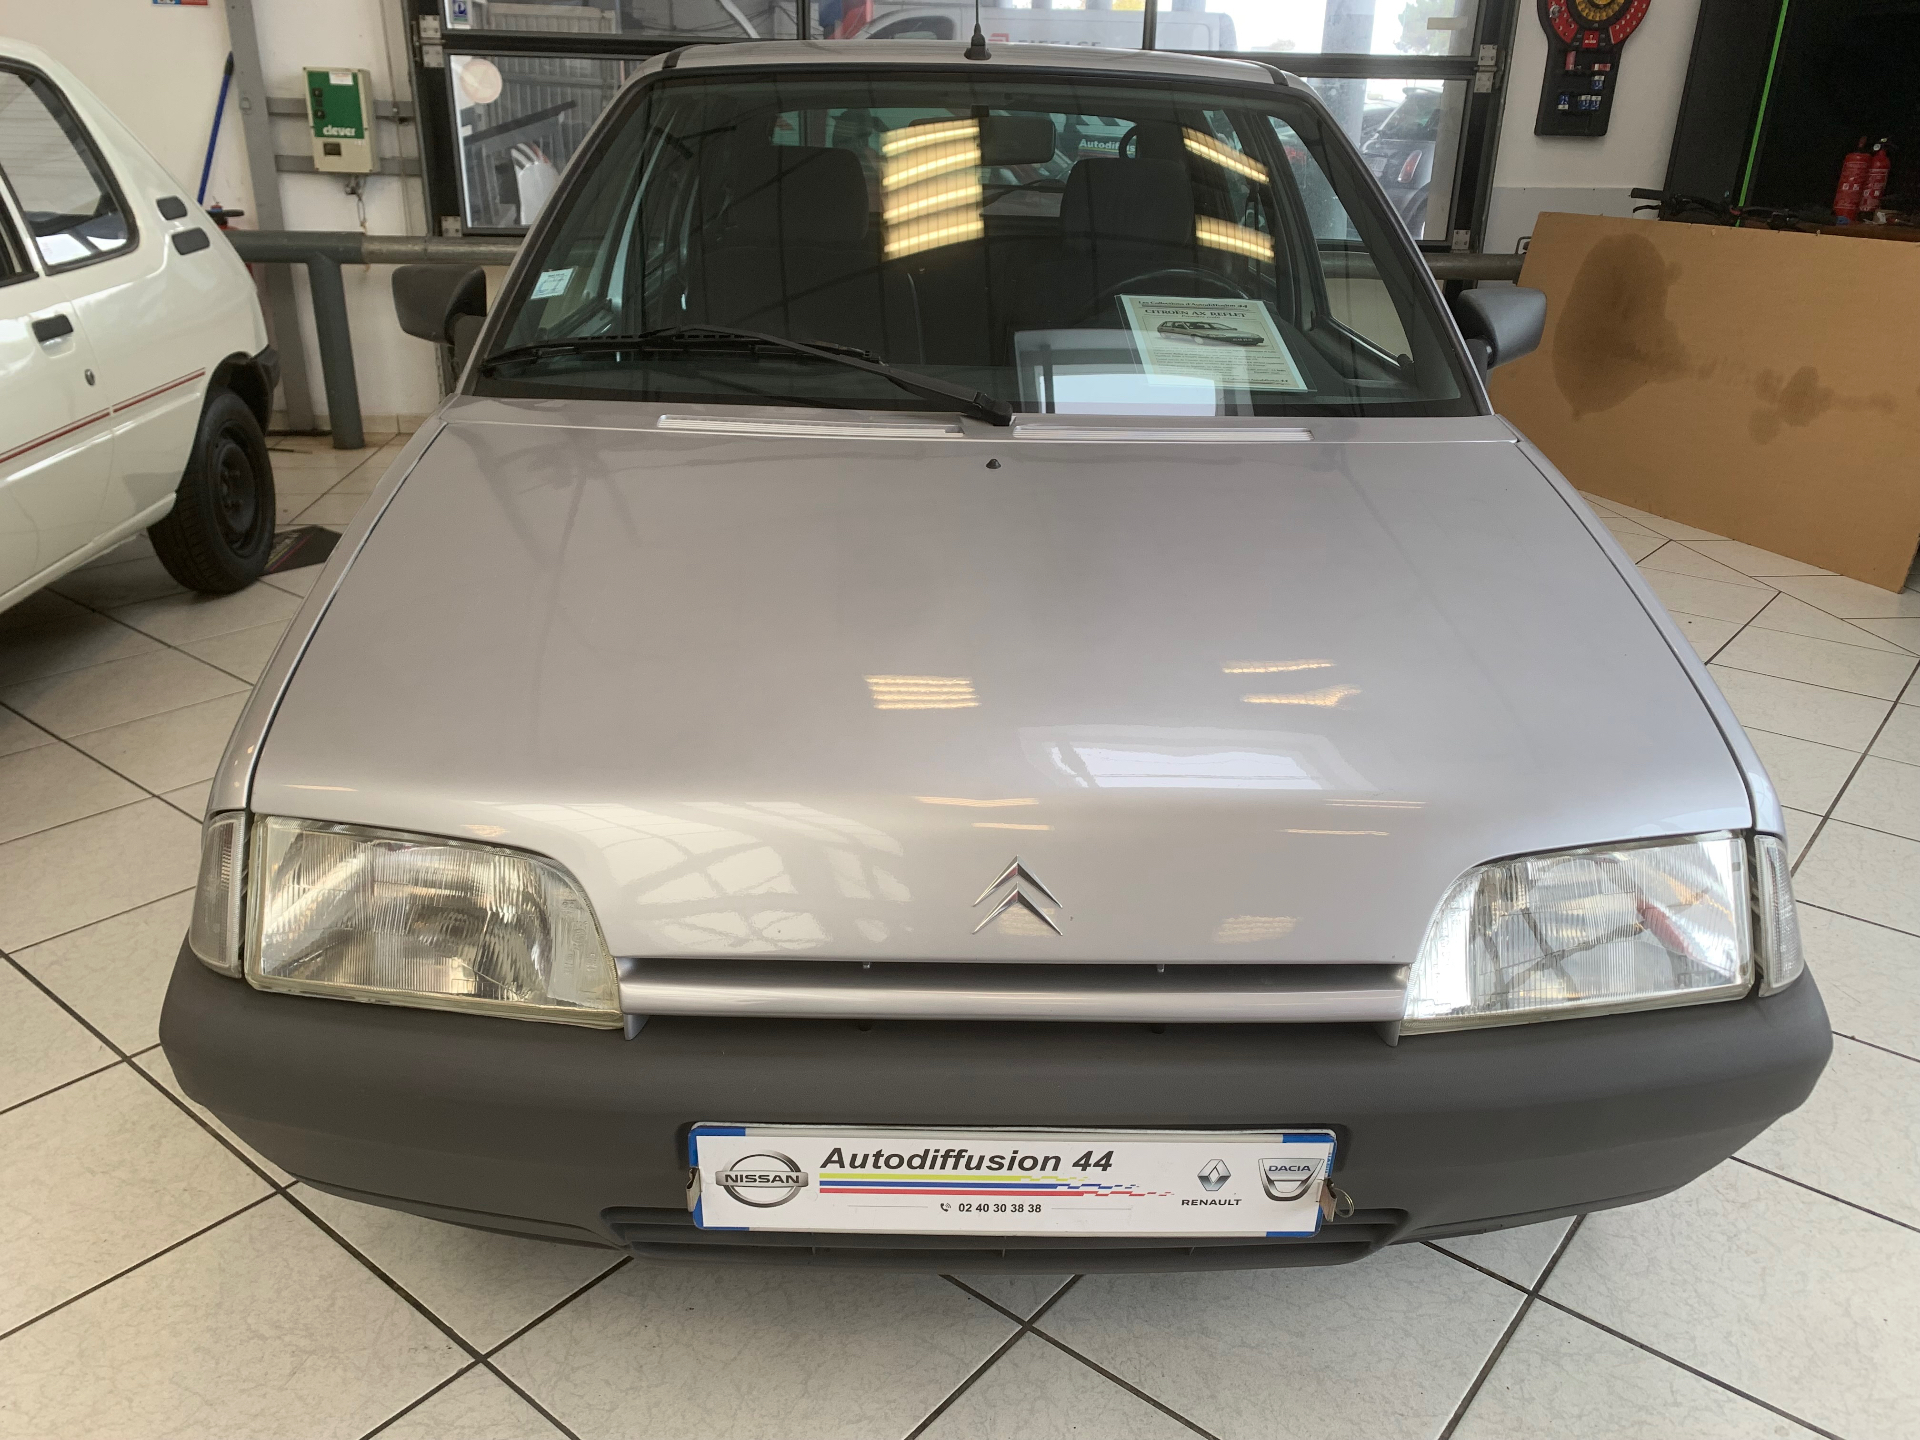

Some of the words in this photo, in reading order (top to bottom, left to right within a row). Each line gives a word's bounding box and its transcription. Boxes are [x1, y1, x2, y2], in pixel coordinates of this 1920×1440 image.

[323, 124, 356, 136] clever
[1079, 139, 1136, 152] Autodifs
[820, 1147, 1061, 1172] Autodiffusion
[1072, 1150, 1114, 1172] 44
[724, 1173, 800, 1184] NISSAN
[1181, 1198, 1242, 1206] RENAULT
[958, 1203, 972, 1212] 02
[975, 1203, 990, 1213] 40
[993, 1203, 1007, 1213] 30
[1010, 1203, 1025, 1213] 38
[1028, 1203, 1042, 1213] 38
